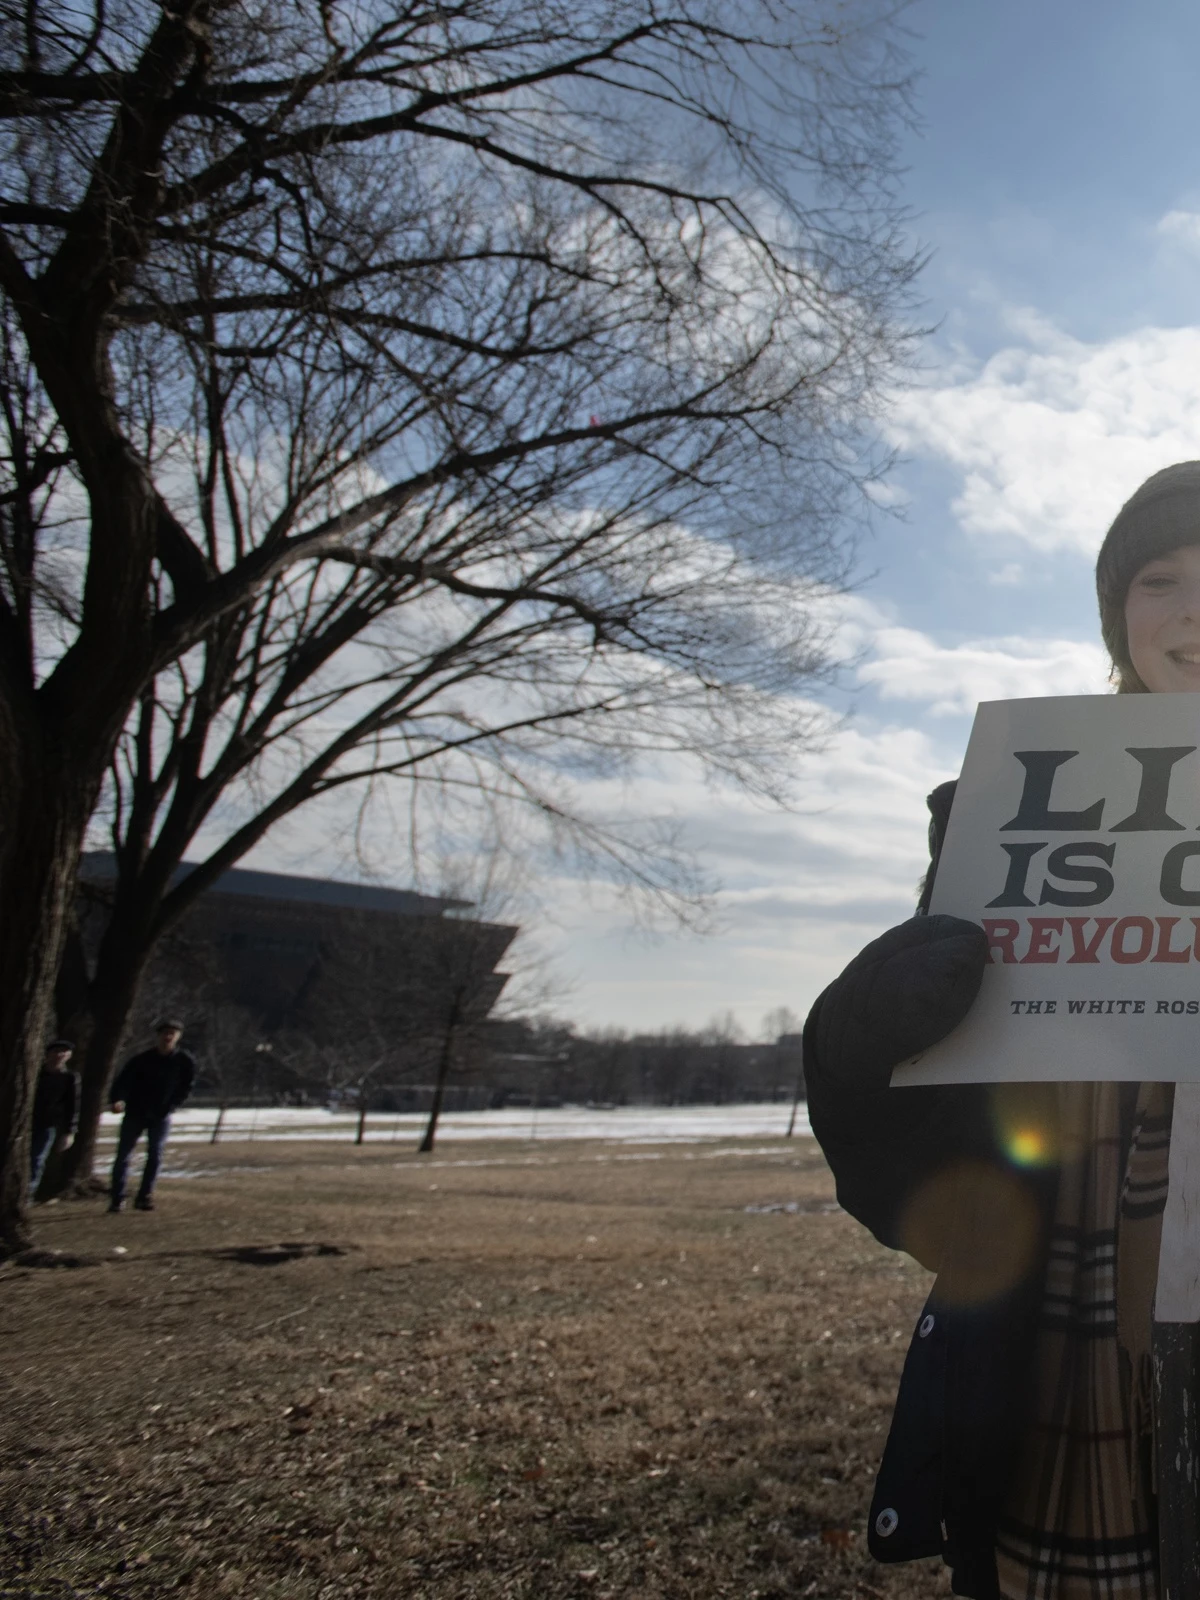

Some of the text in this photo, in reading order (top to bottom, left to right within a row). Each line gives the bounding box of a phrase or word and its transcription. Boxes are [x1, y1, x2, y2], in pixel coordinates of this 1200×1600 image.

[984, 841, 1117, 909] IS
[1010, 1000, 1057, 1015] THE
[1067, 1000, 1146, 1015] WHITE
